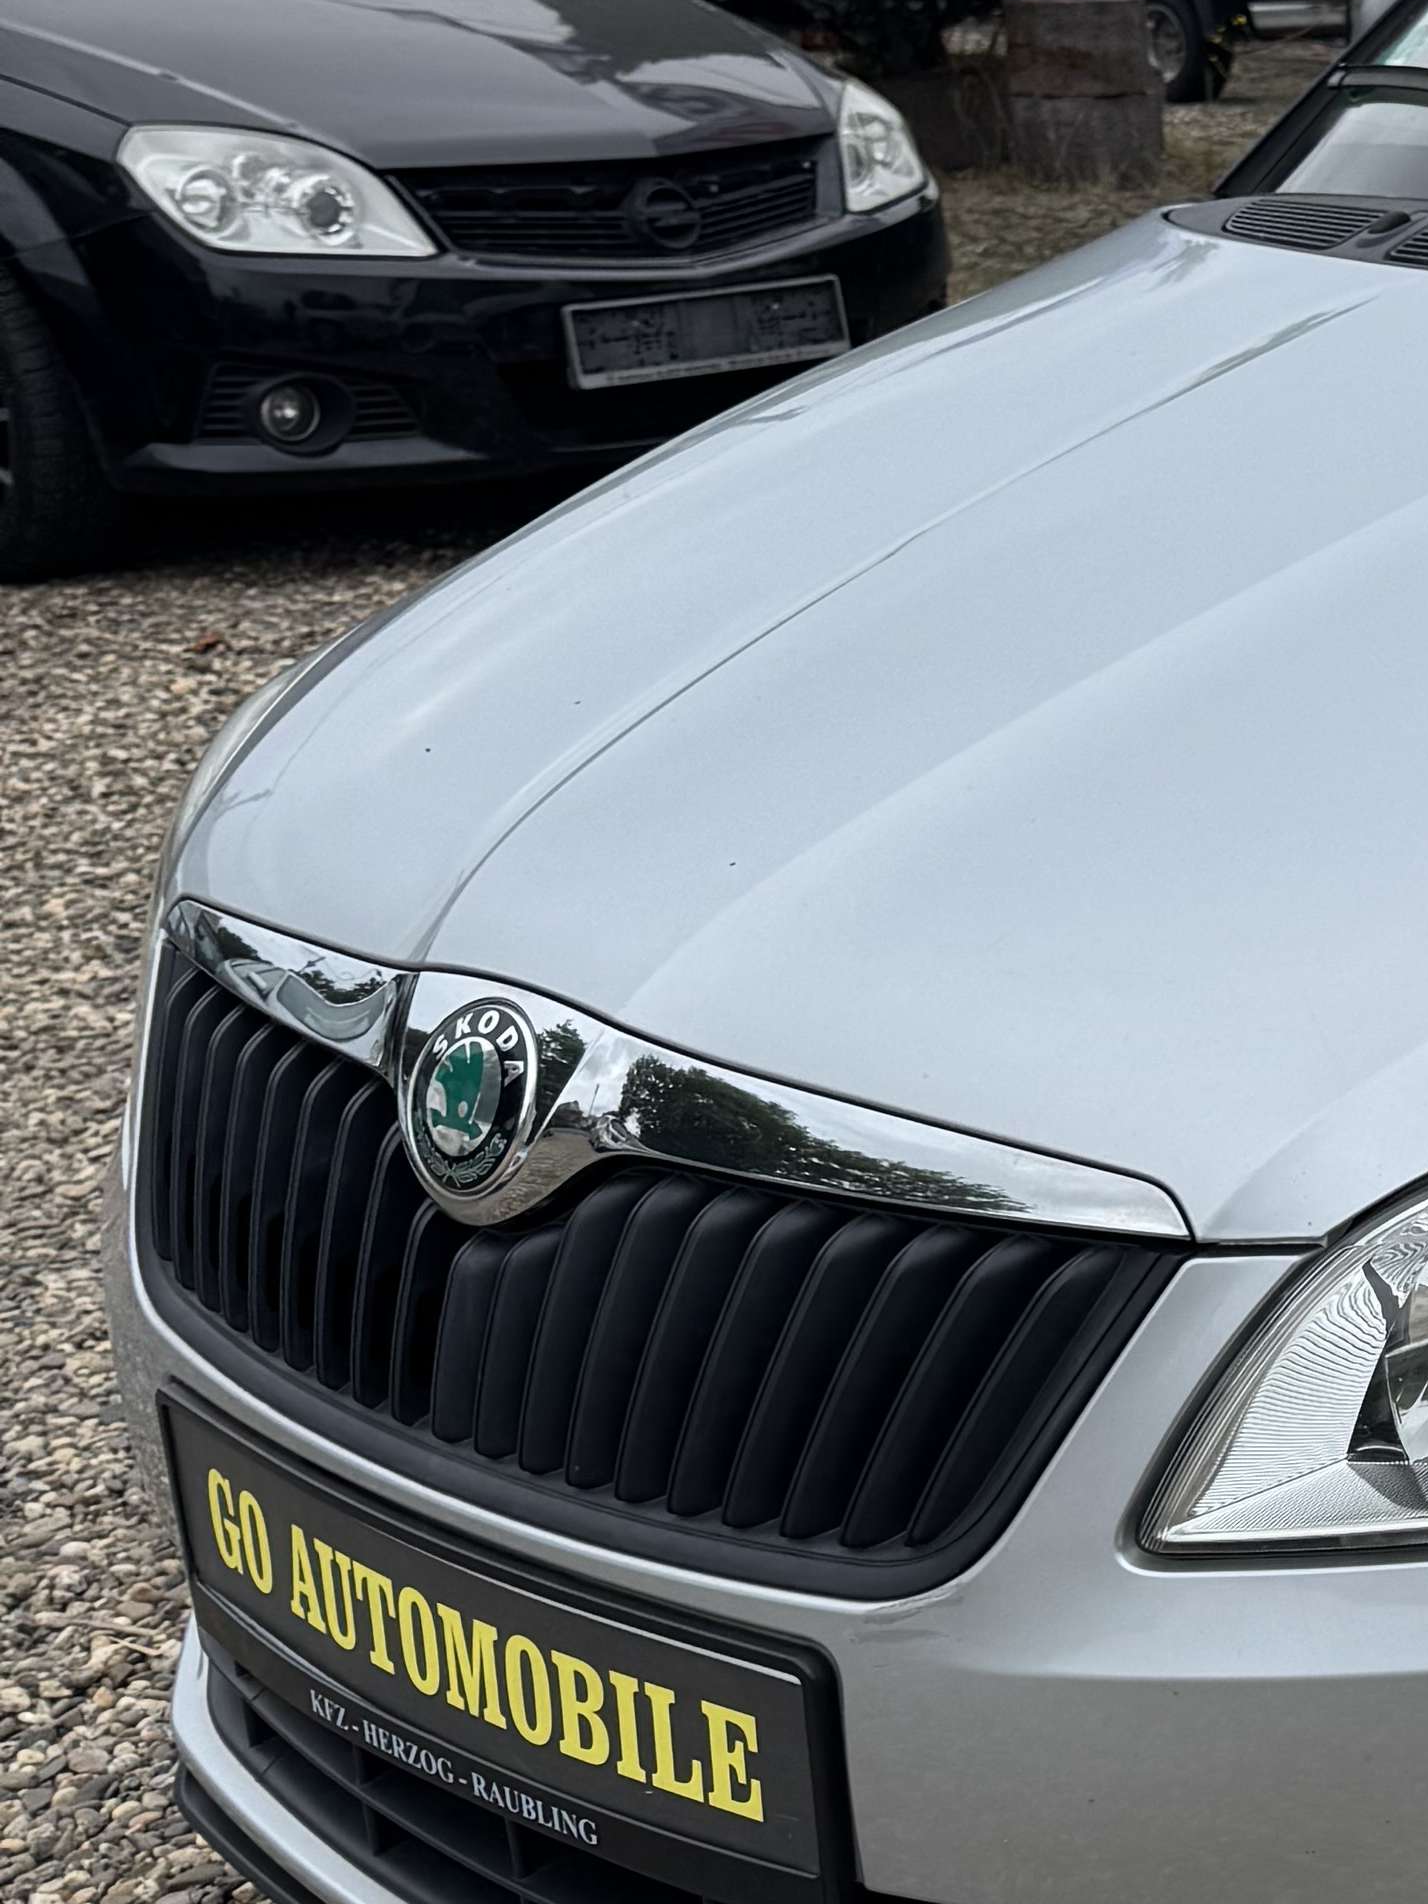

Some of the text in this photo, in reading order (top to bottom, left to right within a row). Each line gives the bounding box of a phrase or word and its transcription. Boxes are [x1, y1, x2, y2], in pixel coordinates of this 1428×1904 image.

[208, 1468, 764, 1823] GO AUTOMOBILE
[310, 1689, 349, 1733] KFZ
[363, 1720, 454, 1785] HERZOG
[472, 1773, 598, 1846] RAUBLING
